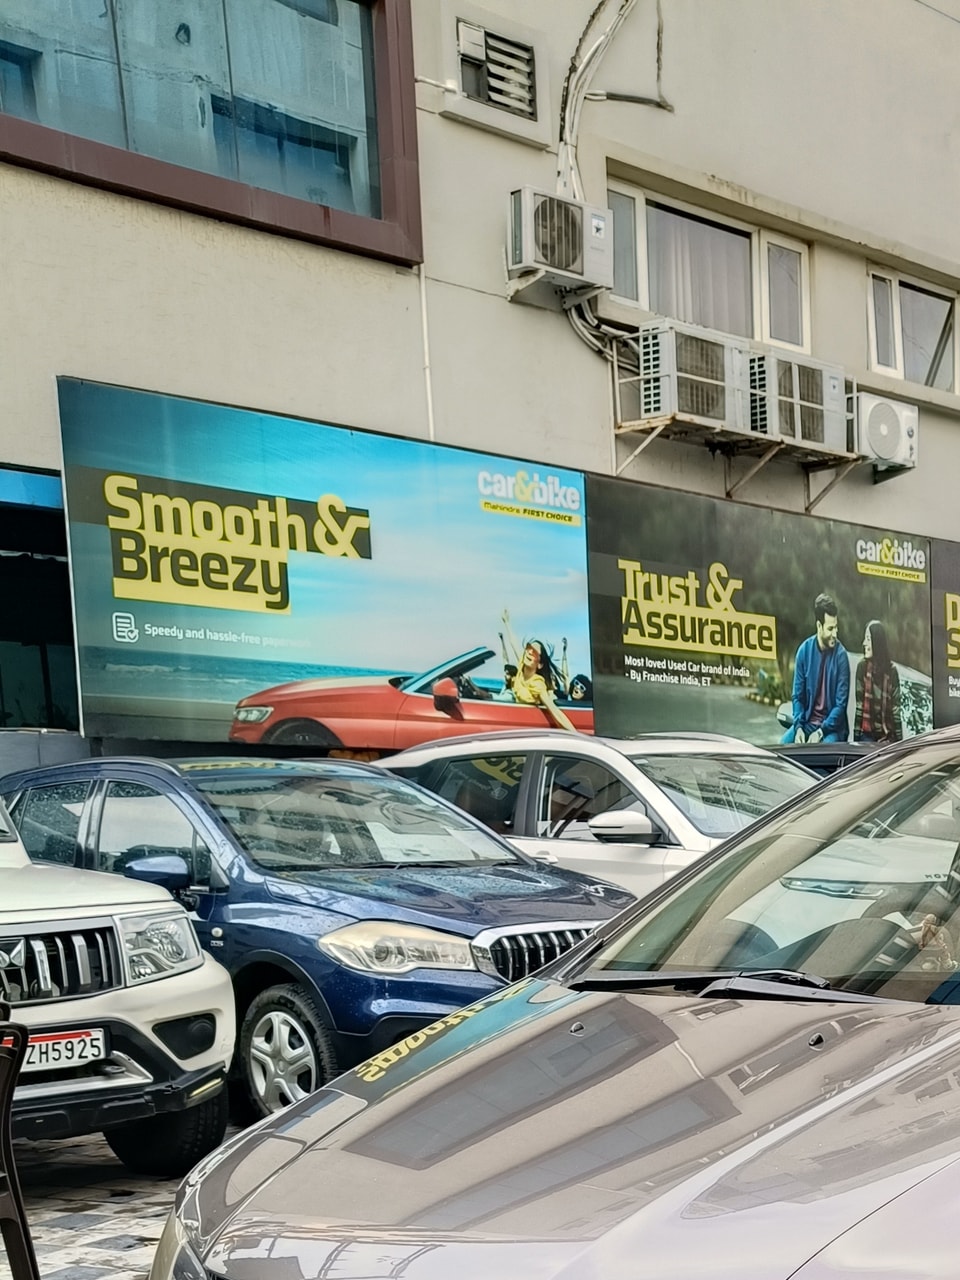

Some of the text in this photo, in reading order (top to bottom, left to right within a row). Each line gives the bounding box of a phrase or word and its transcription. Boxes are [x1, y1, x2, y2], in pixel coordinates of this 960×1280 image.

[478, 470, 580, 511] car&bike
[104, 475, 369, 559] Smooth &
[523, 508, 545, 518] FIRST
[546, 512, 573, 523] CHOICE
[111, 527, 289, 610] Breezy
[856, 538, 926, 570] car&bike
[618, 559, 743, 612] Trust &
[144, 624, 183, 640] Speedy
[185, 628, 204, 639] and
[206, 629, 261, 645] hassle-free
[622, 600, 774, 651] Assurance
[625, 655, 750, 677] Most loved Used Car brand of India
[630, 670, 641, 682] By
[643, 671, 679, 683] Franchise
[680, 674, 700, 687] India,
[702, 677, 711, 686] ET
[948, 675, 960, 687] Buy
